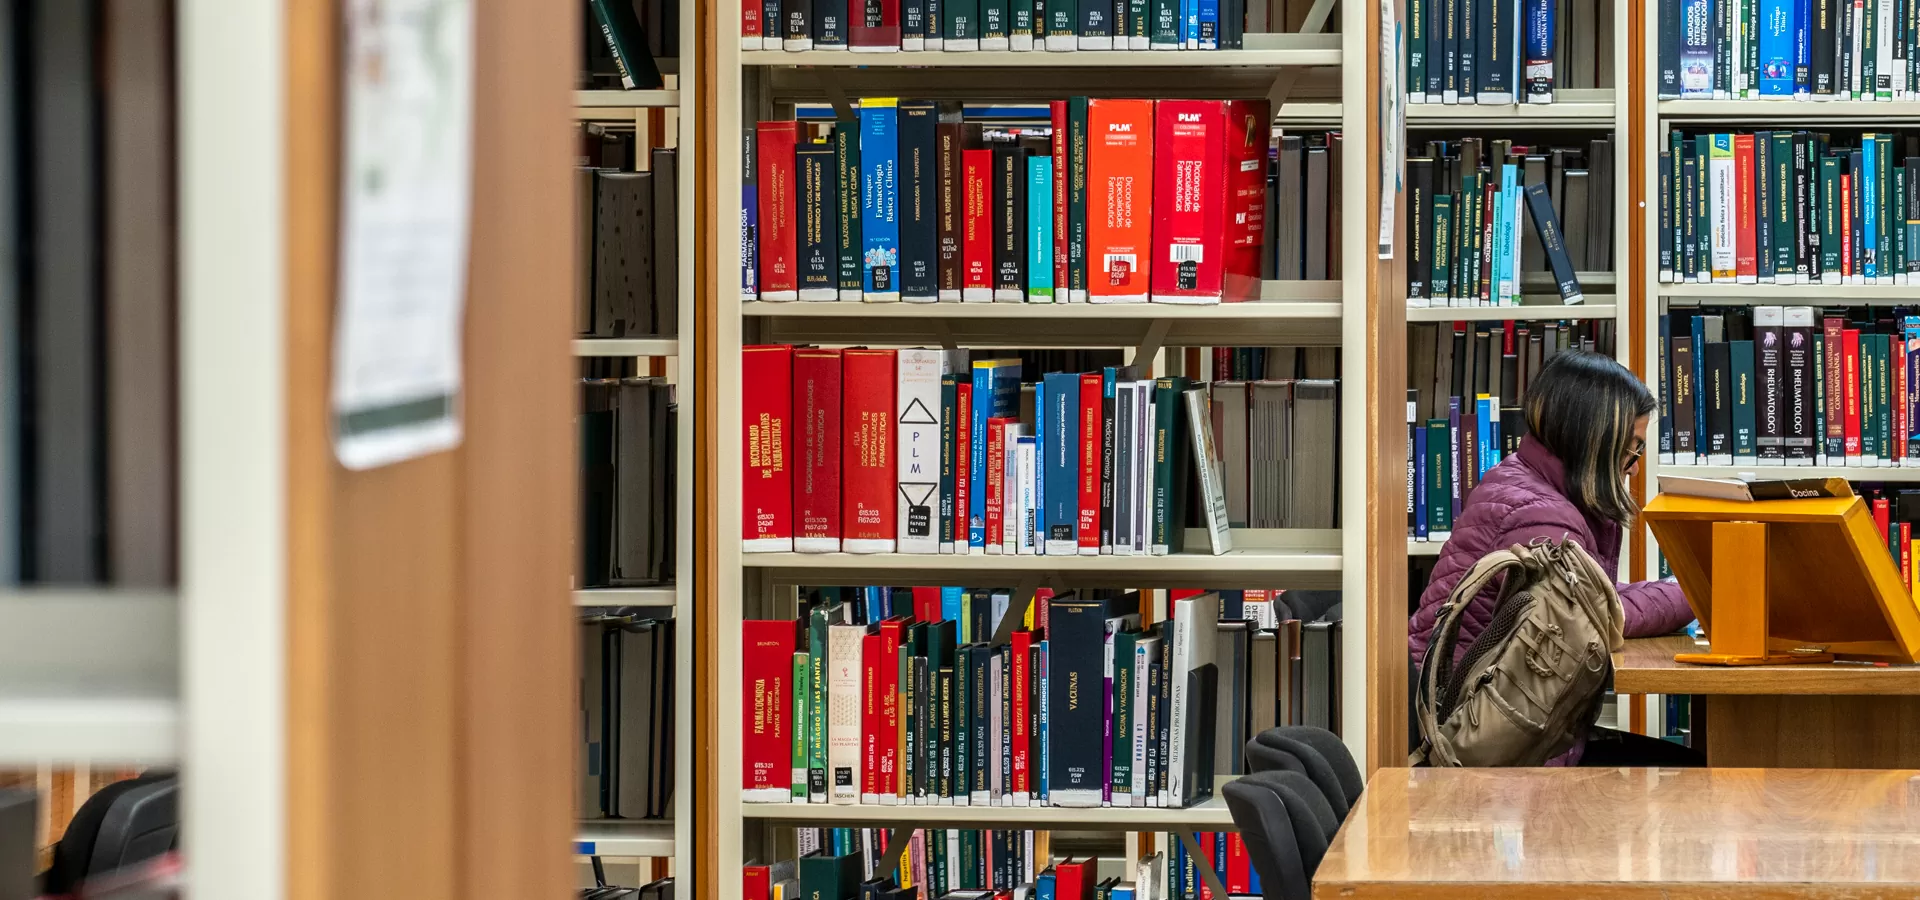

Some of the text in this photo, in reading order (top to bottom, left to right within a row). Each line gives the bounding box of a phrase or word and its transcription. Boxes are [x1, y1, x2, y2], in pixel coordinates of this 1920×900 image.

[1107, 176, 1116, 228] Farmacéuticas
[1116, 176, 1124, 228] Especialidades
[1125, 176, 1133, 217] Diccionario
[1184, 160, 1193, 212] Especialidades
[1193, 160, 1202, 213] Diccionario de
[1503, 221, 1512, 256] Diabetología
[1767, 368, 1776, 434] RHEUMATOLOGY
[1794, 369, 1802, 435] RHEUMATOLOGY
[750, 424, 760, 468] DICCIONARIO
[760, 412, 773, 478] DE ESPECIALIDADES
[772, 418, 783, 473] FARMACEUTICAS
[1104, 448, 1112, 480] Chemistry
[1791, 489, 1820, 498] Cocina
[754, 679, 765, 734] FARMACOGNOSIA
[1070, 672, 1078, 710] VACUNAS
